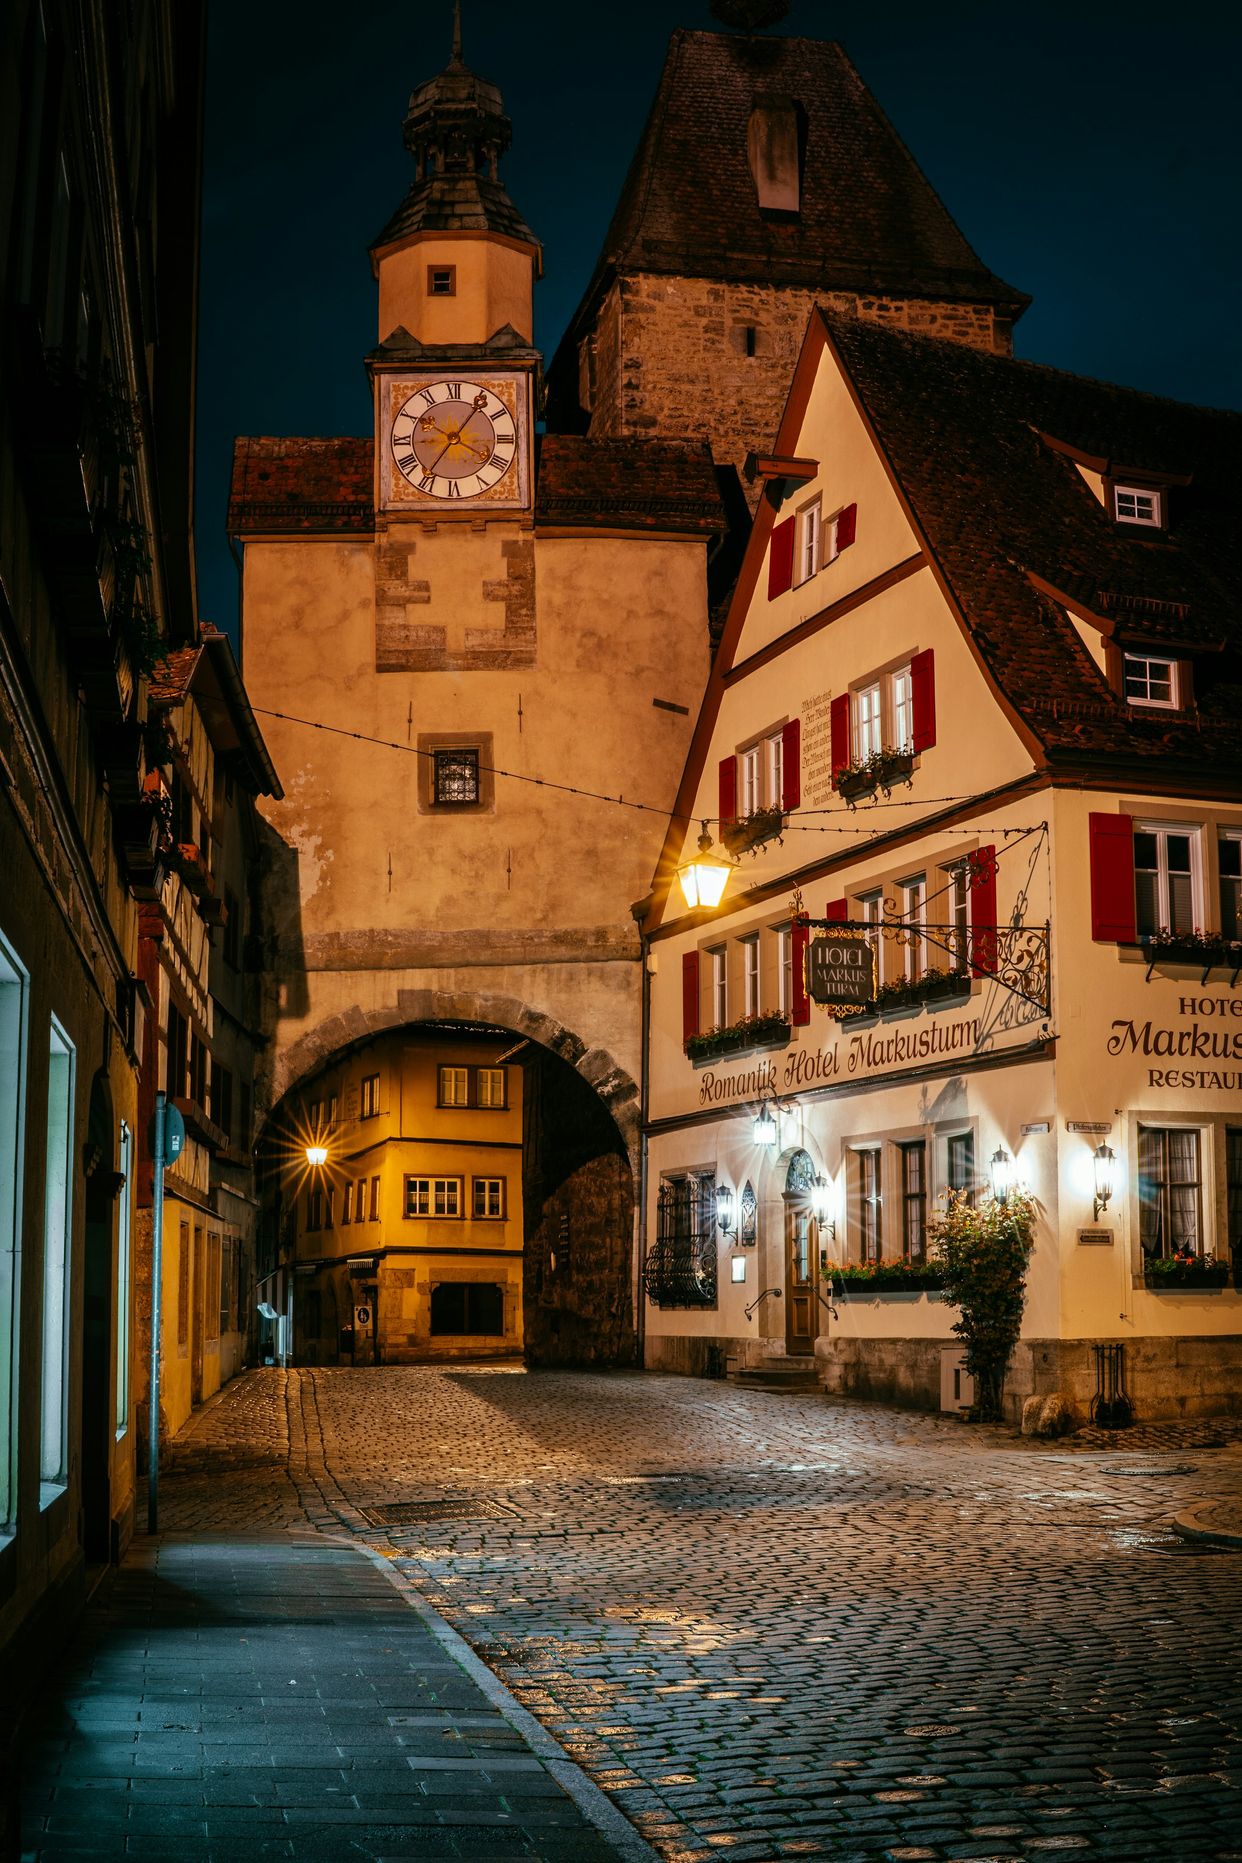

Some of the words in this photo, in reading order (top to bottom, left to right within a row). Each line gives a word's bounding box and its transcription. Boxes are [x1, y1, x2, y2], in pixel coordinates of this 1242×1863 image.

[419, 389, 436, 408] XI
[445, 383, 462, 400] XII
[489, 407, 507, 422] II
[496, 433, 514, 445] III
[448, 480, 462, 497] VI
[476, 474, 490, 490] V
[818, 947, 864, 966] HOTEL
[817, 969, 867, 982] MARKUS
[825, 982, 860, 996] TURM
[699, 1059, 777, 1105] Romantik
[783, 1042, 840, 1088] Hotel
[847, 1018, 980, 1073] Markusturm
